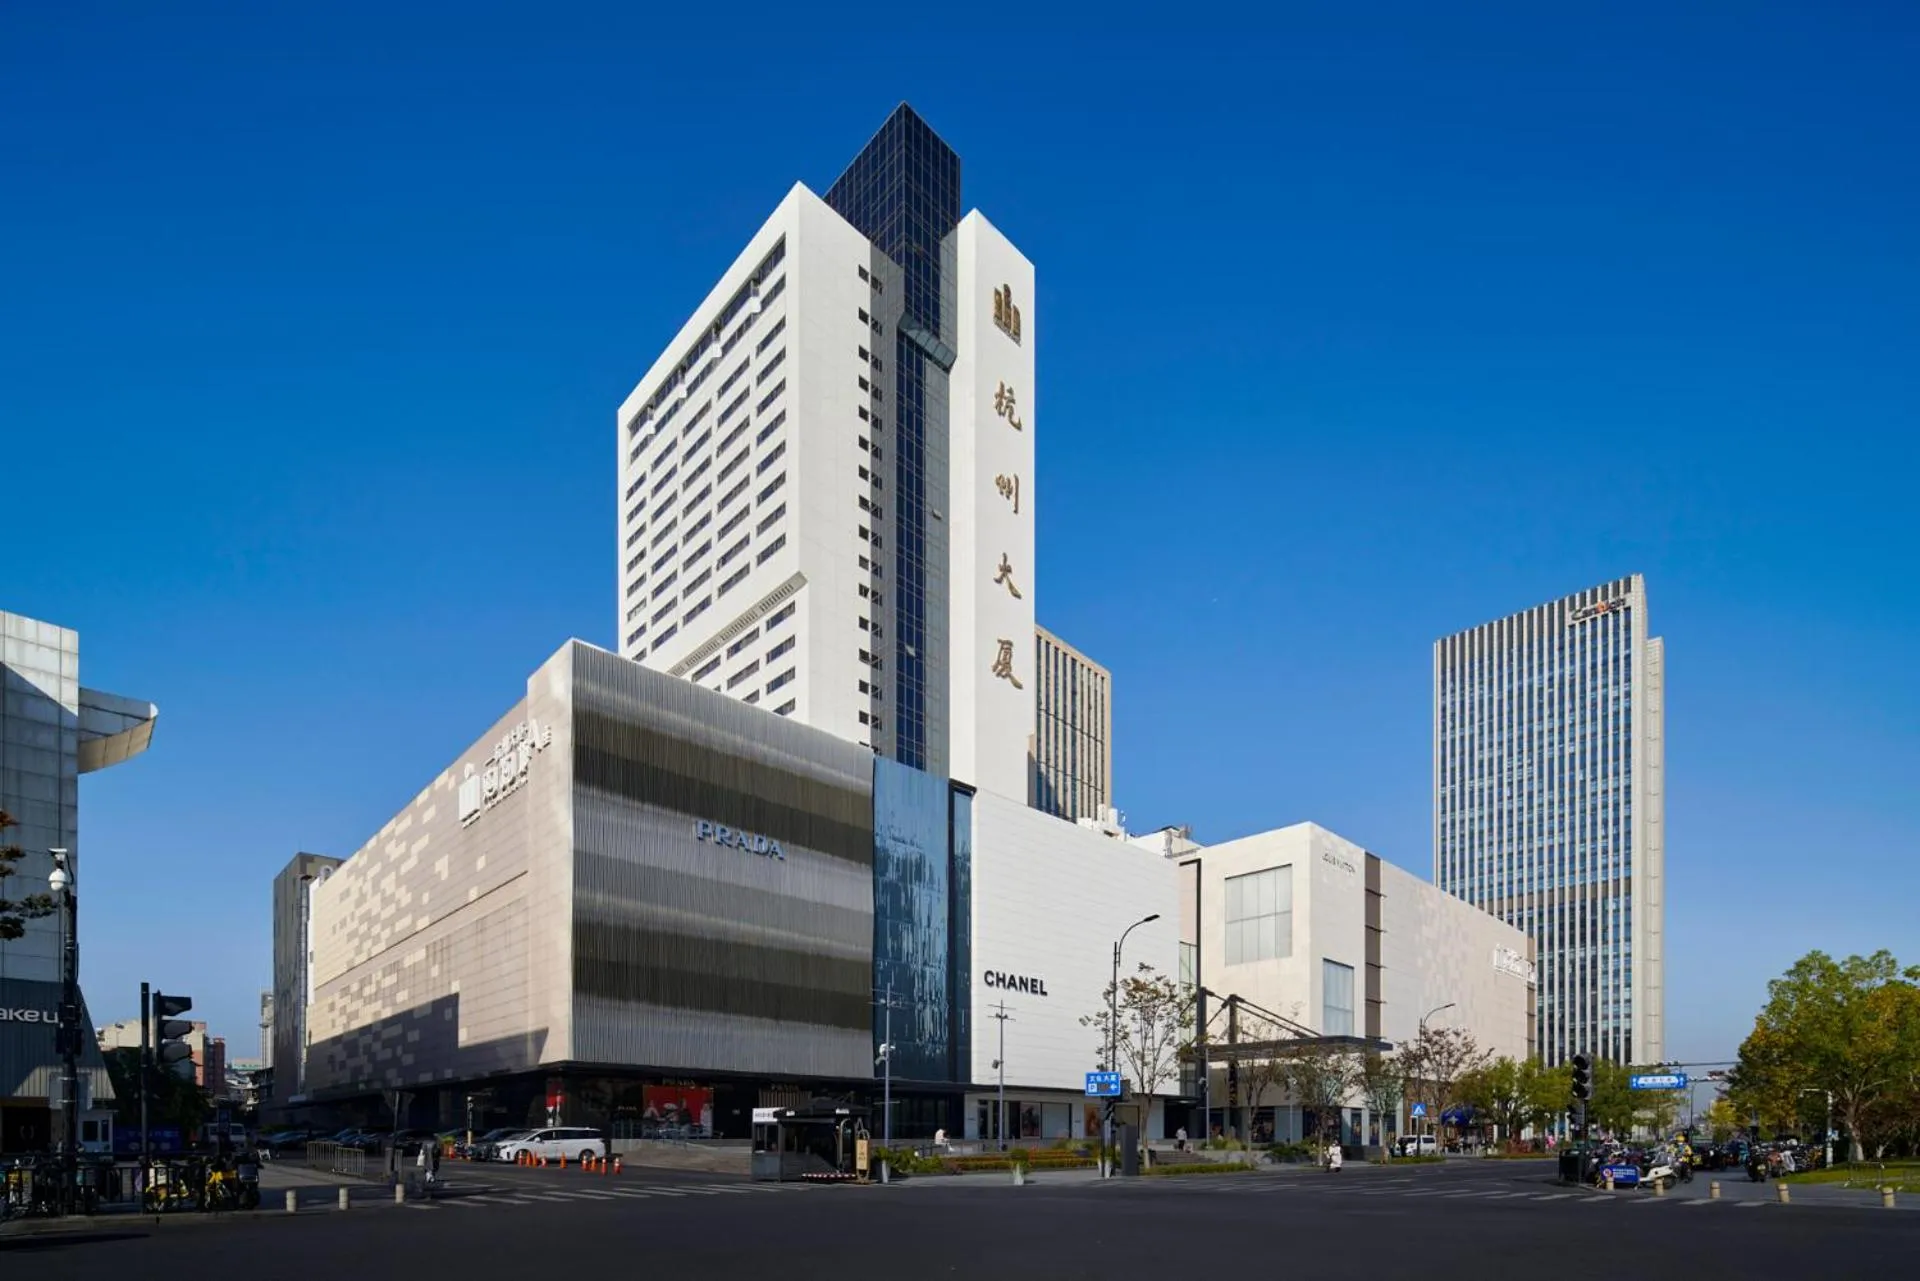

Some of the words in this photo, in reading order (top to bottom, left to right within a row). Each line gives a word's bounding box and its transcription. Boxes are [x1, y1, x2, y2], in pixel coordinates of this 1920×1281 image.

[993, 381, 1023, 691] 杭州大厦
[696, 819, 785, 860] PRADA
[984, 970, 1048, 997] CHANEL
